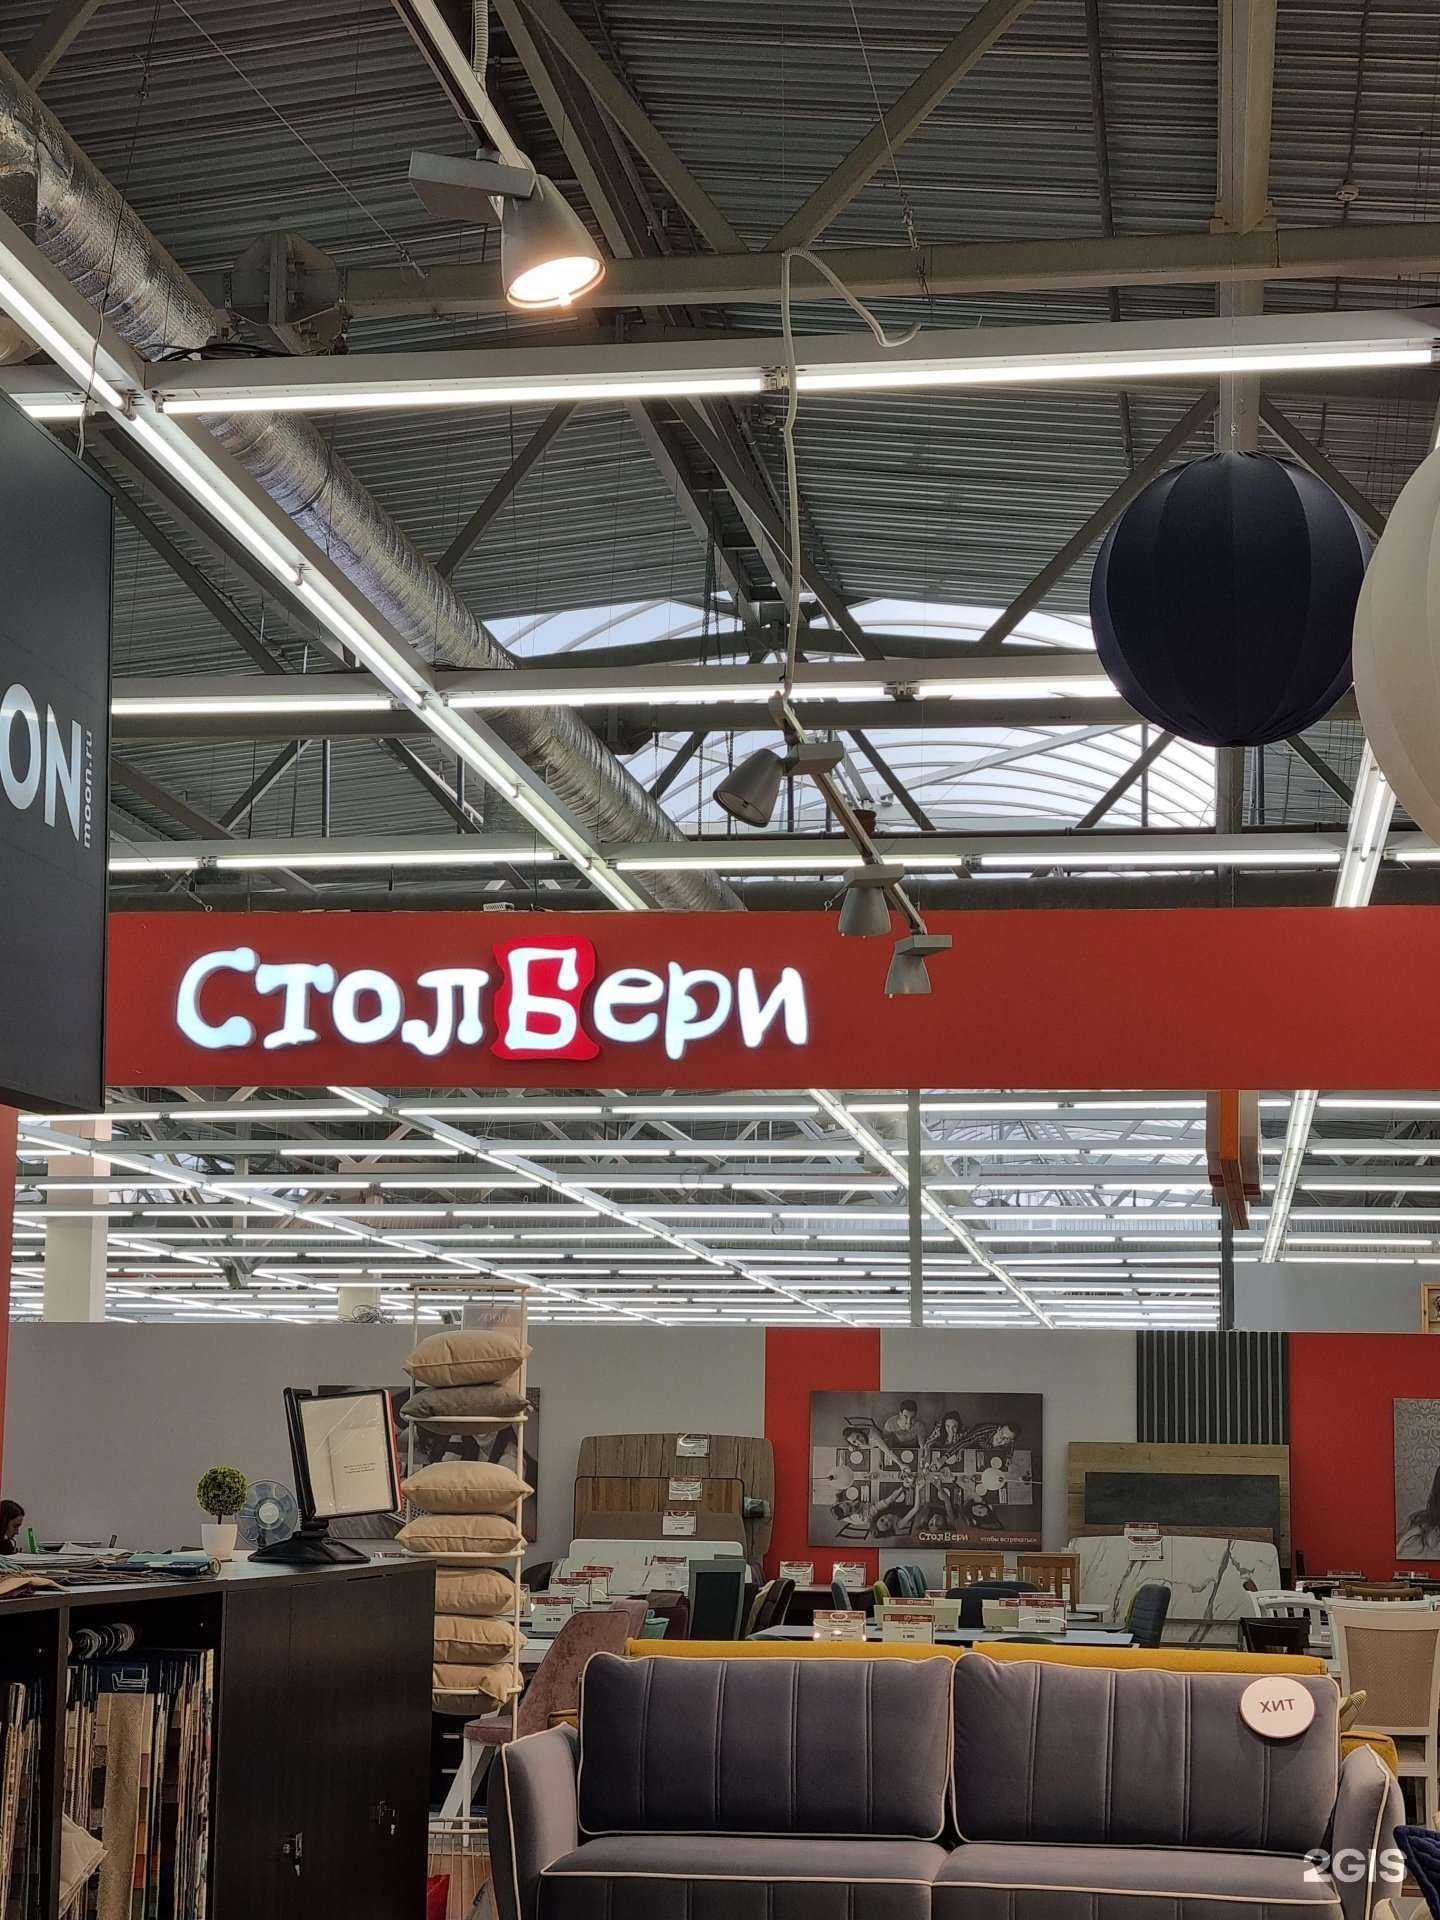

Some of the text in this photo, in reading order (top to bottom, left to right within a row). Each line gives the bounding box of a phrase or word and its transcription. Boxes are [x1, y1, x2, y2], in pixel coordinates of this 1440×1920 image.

[0, 683, 81, 841] ON
[84, 730, 93, 848] moon.ru
[176, 946, 808, 1060] СтолБери
[1259, 1698, 1296, 1713] ХИТ
